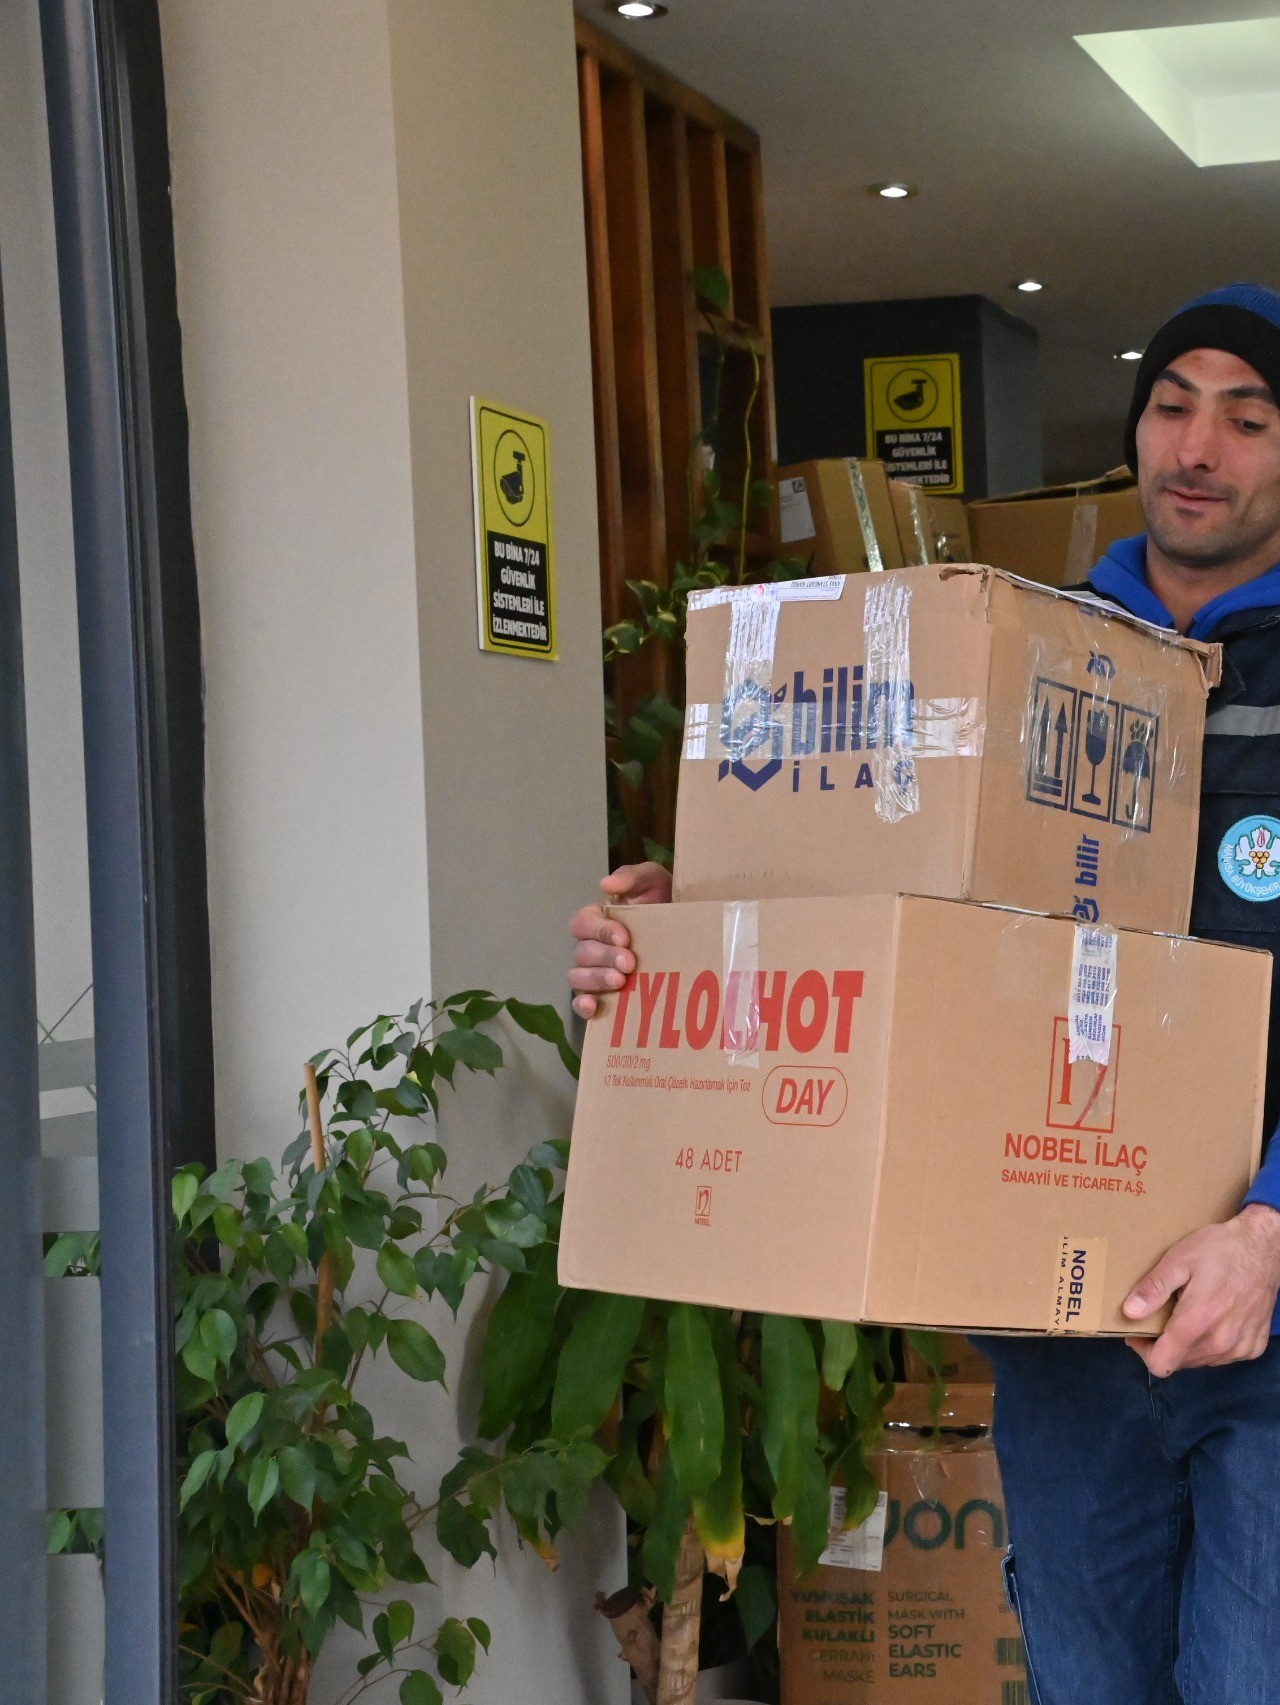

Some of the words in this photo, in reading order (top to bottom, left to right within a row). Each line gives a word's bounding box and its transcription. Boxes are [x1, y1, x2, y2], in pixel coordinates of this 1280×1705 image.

[922, 431, 943, 442] 7/24
[494, 540, 505, 559] BU
[506, 541, 524, 563] BİNA
[524, 546, 540, 566] 7/24
[500, 565, 536, 590] GÜVENLİK
[493, 589, 534, 614] SİSTEMLERİ
[534, 596, 545, 617] İLE
[492, 613, 548, 641] İZLENMEKTEDİR
[640, 1058, 651, 1071] mg
[612, 1074, 622, 1087] Tek
[654, 1076, 667, 1088] Oral
[740, 1079, 750, 1092] Toz
[775, 1077, 836, 1115] DAY
[675, 1147, 694, 1169] 48
[700, 1148, 743, 1172] ADET
[1004, 1132, 1088, 1164] NOBEL
[1094, 1135, 1148, 1176] İLAÇ
[1054, 1173, 1070, 1188] VE
[1072, 1172, 1122, 1192] TİCARET
[1124, 1180, 1146, 1196] A.Ş.
[694, 1218, 710, 1226] NOBEL
[1066, 1249, 1087, 1323] NOBEL
[887, 1590, 954, 1602] SURGICAL
[804, 1608, 875, 1625] ELASTİK
[888, 1609, 926, 1620] MASK
[930, 1608, 966, 1620] WITH
[802, 1628, 876, 1644] KULAKLI
[888, 1624, 936, 1640] SOFT
[888, 1643, 962, 1659] ELASTIC
[888, 1662, 937, 1678] EARS
